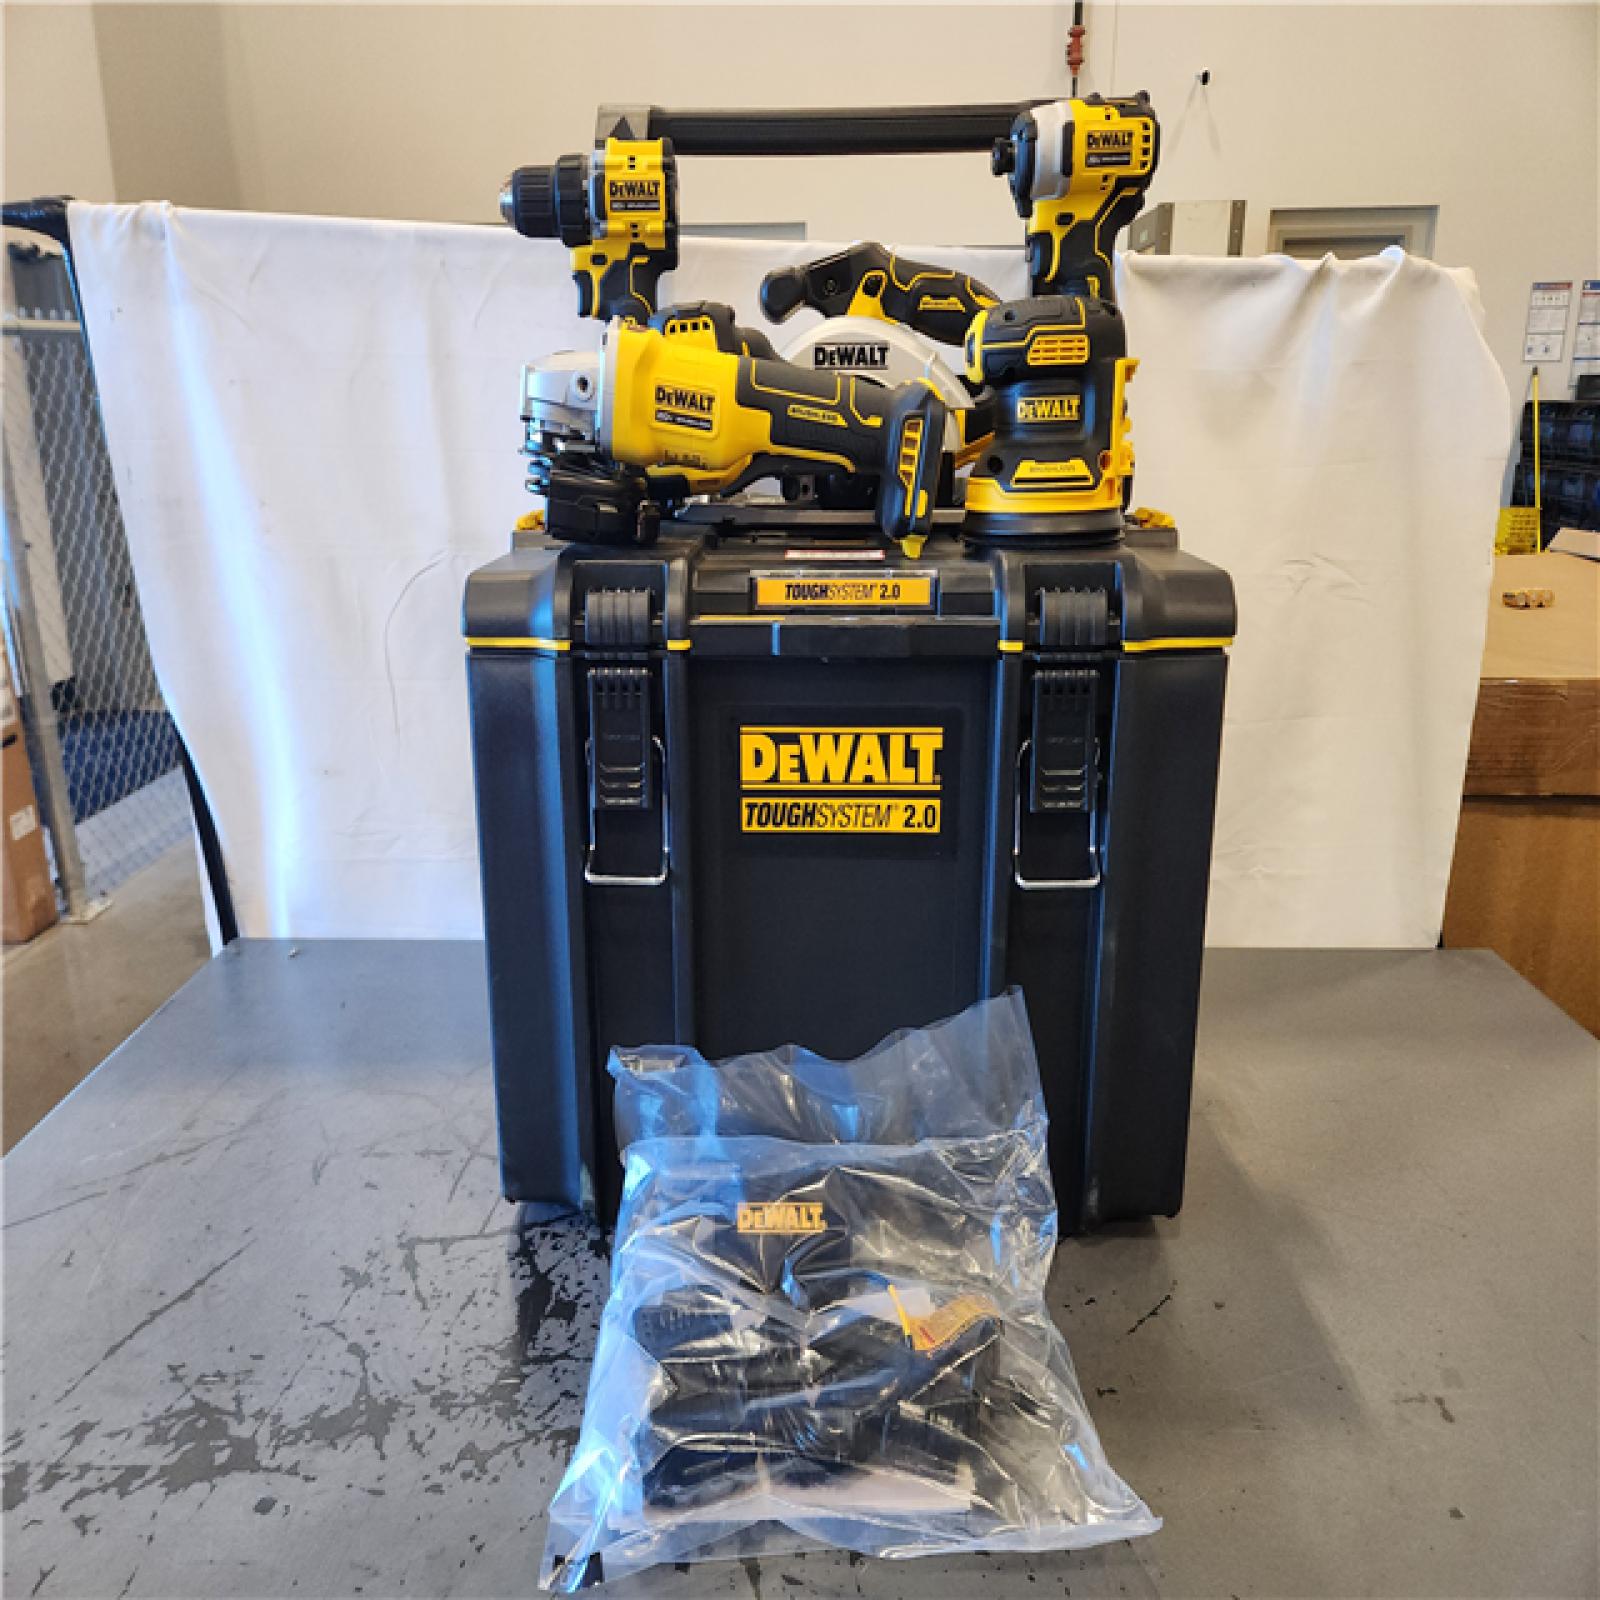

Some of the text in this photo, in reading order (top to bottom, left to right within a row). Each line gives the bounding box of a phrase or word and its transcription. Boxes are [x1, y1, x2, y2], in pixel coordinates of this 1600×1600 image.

[609, 180, 660, 198] DEWALT
[815, 341, 889, 369] DEWALT
[655, 386, 715, 413] DEWALT
[1017, 395, 1081, 422] DEWALT
[879, 583, 901, 600] 2.0
[740, 729, 943, 787] DEWALT
[744, 802, 937, 828] TOUGHSYSTEM 2.0
[737, 1203, 827, 1233] DEWALT
